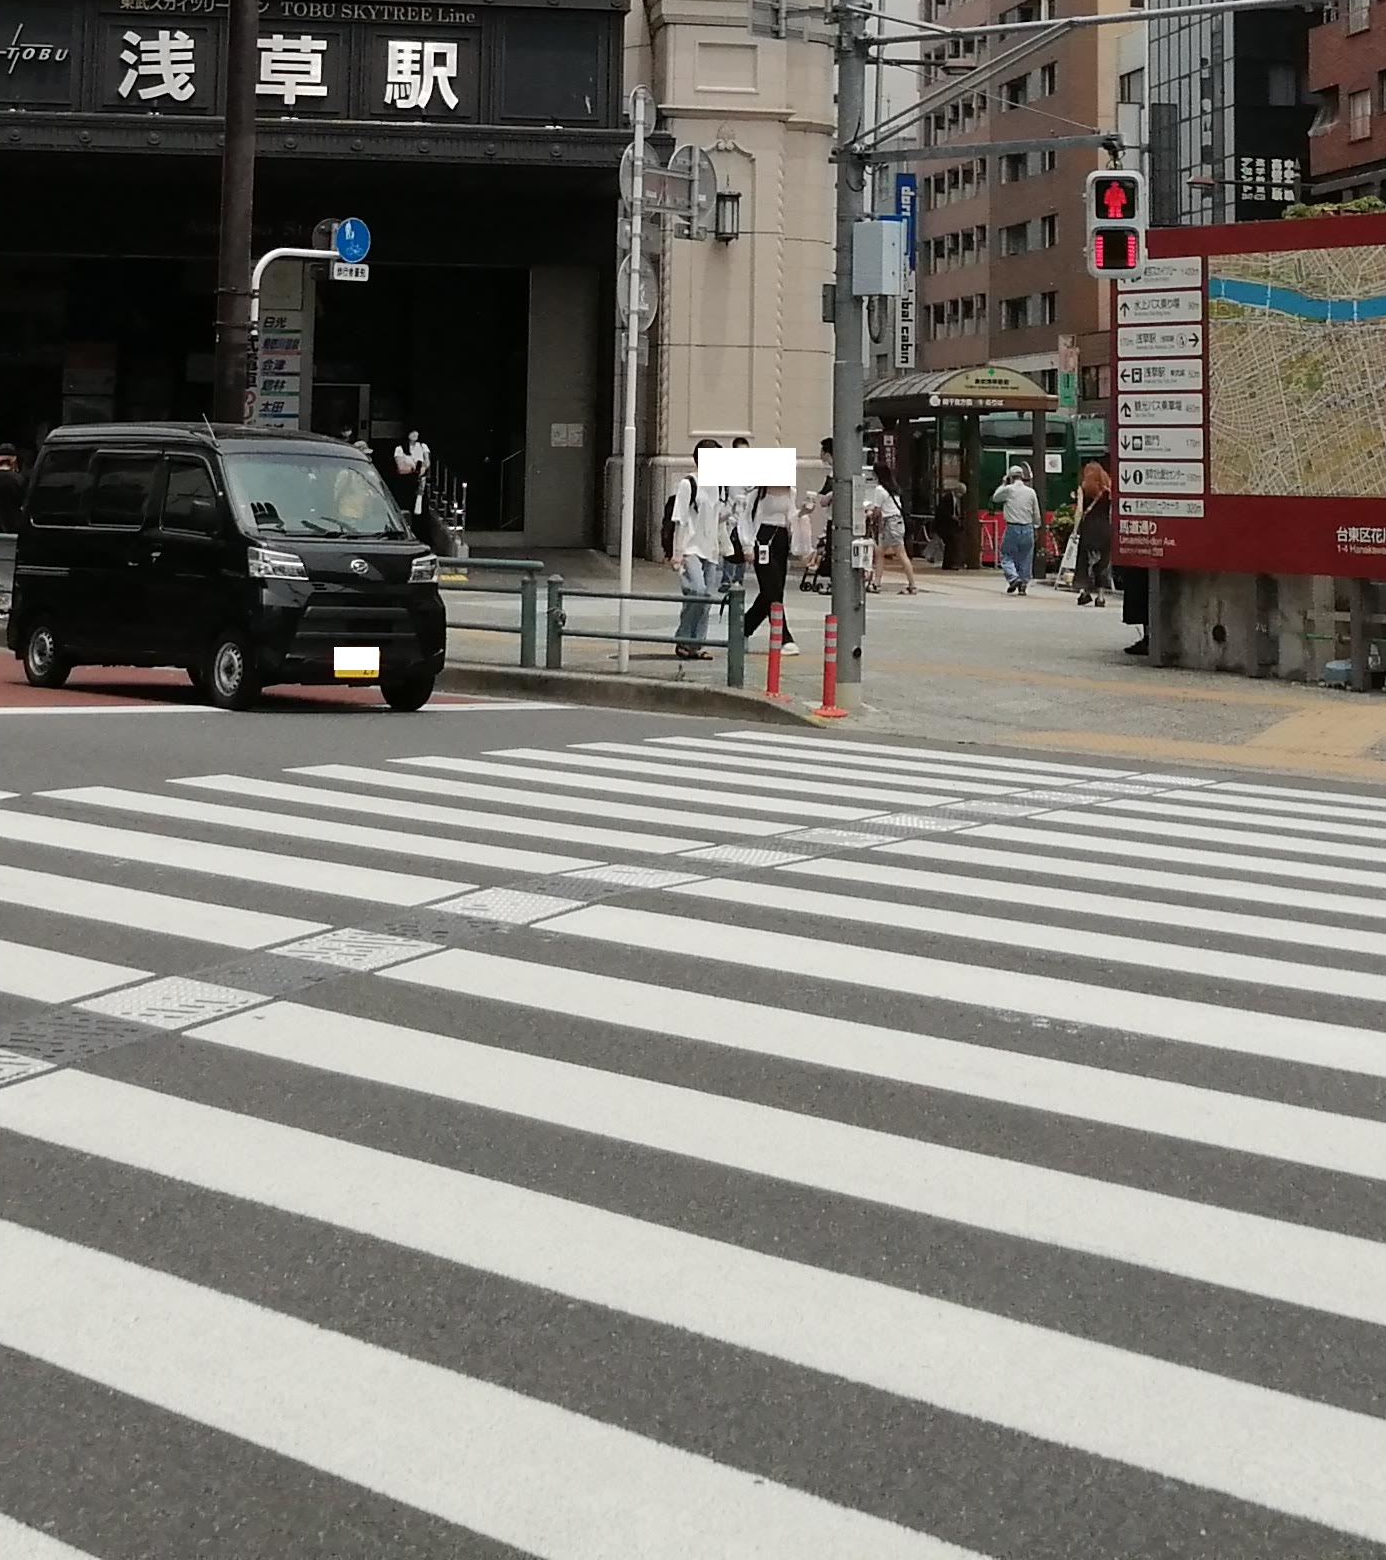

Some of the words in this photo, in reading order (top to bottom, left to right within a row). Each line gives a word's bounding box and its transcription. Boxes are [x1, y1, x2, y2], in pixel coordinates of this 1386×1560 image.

[281, 1, 336, 20] TOBU
[341, 4, 434, 23] SKYTREE
[438, 8, 476, 24] Line
[6, 46, 69, 62] TOBU
[118, 30, 459, 111] 浅草駅
[264, 316, 287, 329] 日光
[901, 326, 913, 364] cabin
[259, 401, 285, 413] 太田
[1337, 544, 1348, 553] 1-4
